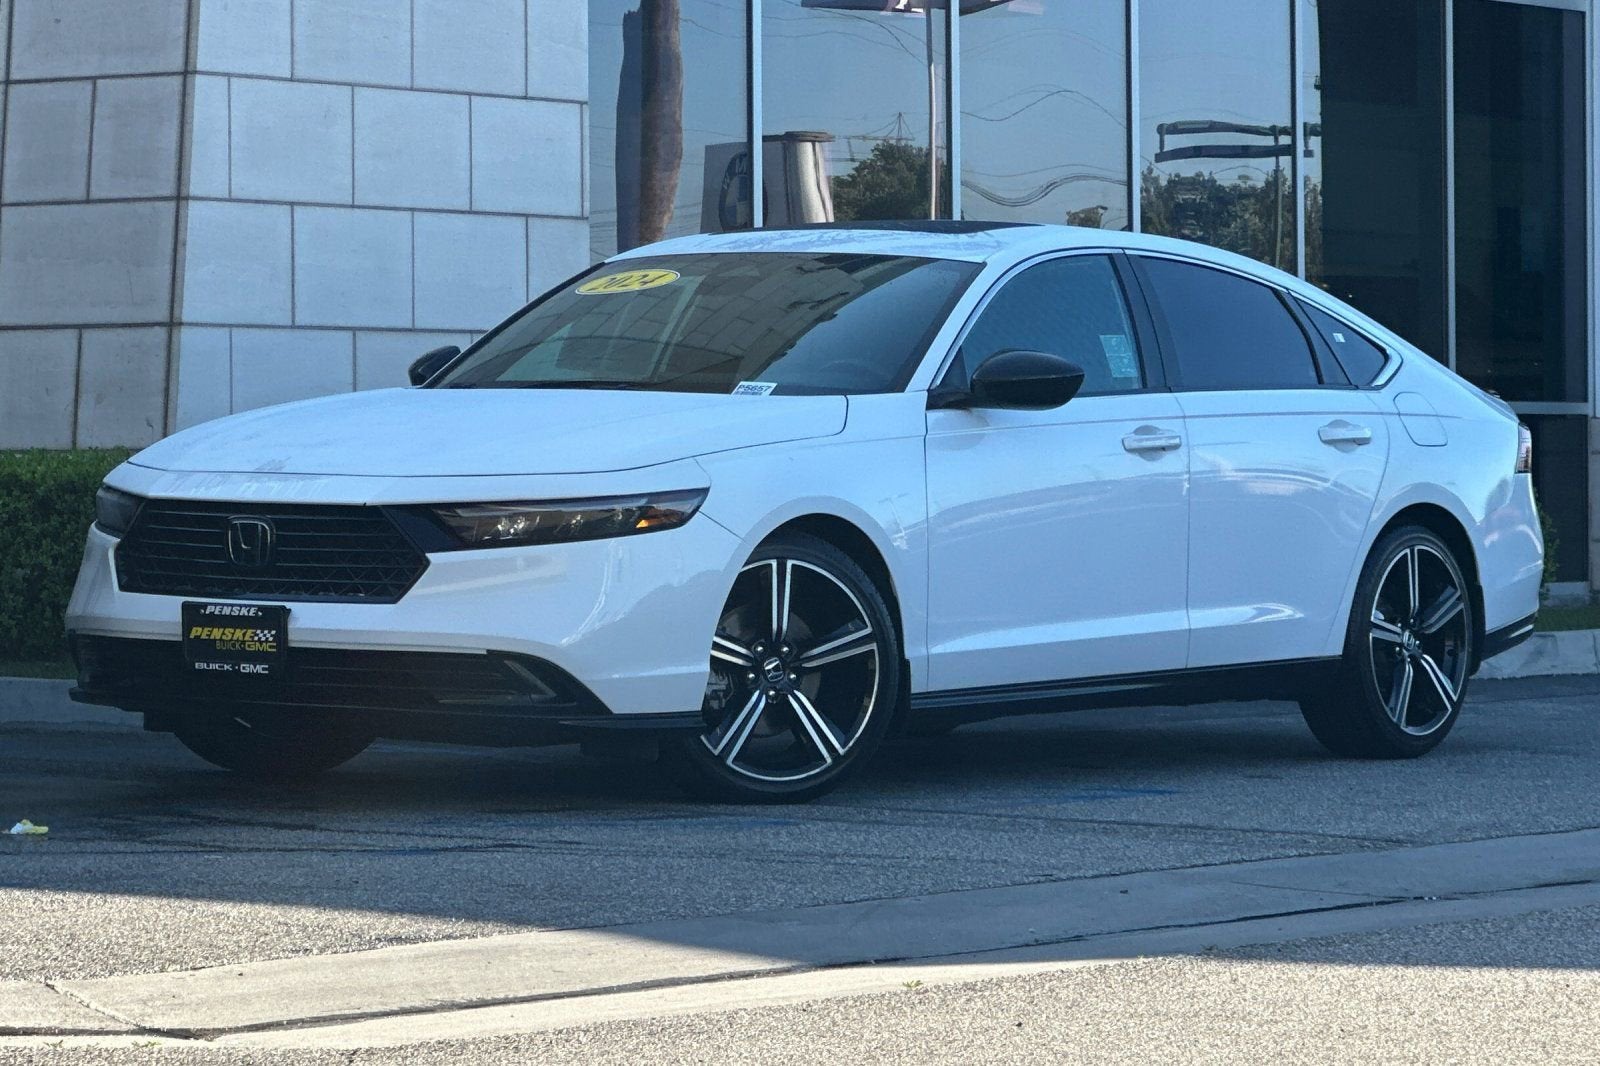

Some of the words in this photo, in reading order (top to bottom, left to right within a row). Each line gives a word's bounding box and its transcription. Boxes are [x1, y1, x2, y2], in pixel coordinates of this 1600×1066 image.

[585, 273, 668, 291] 2024
[205, 605, 258, 616] PENSKE
[190, 627, 256, 640] PENSKE
[216, 640, 241, 650] BUICK
[245, 642, 277, 652] GMC
[195, 662, 233, 671] BUICK
[240, 664, 269, 674] GMC
